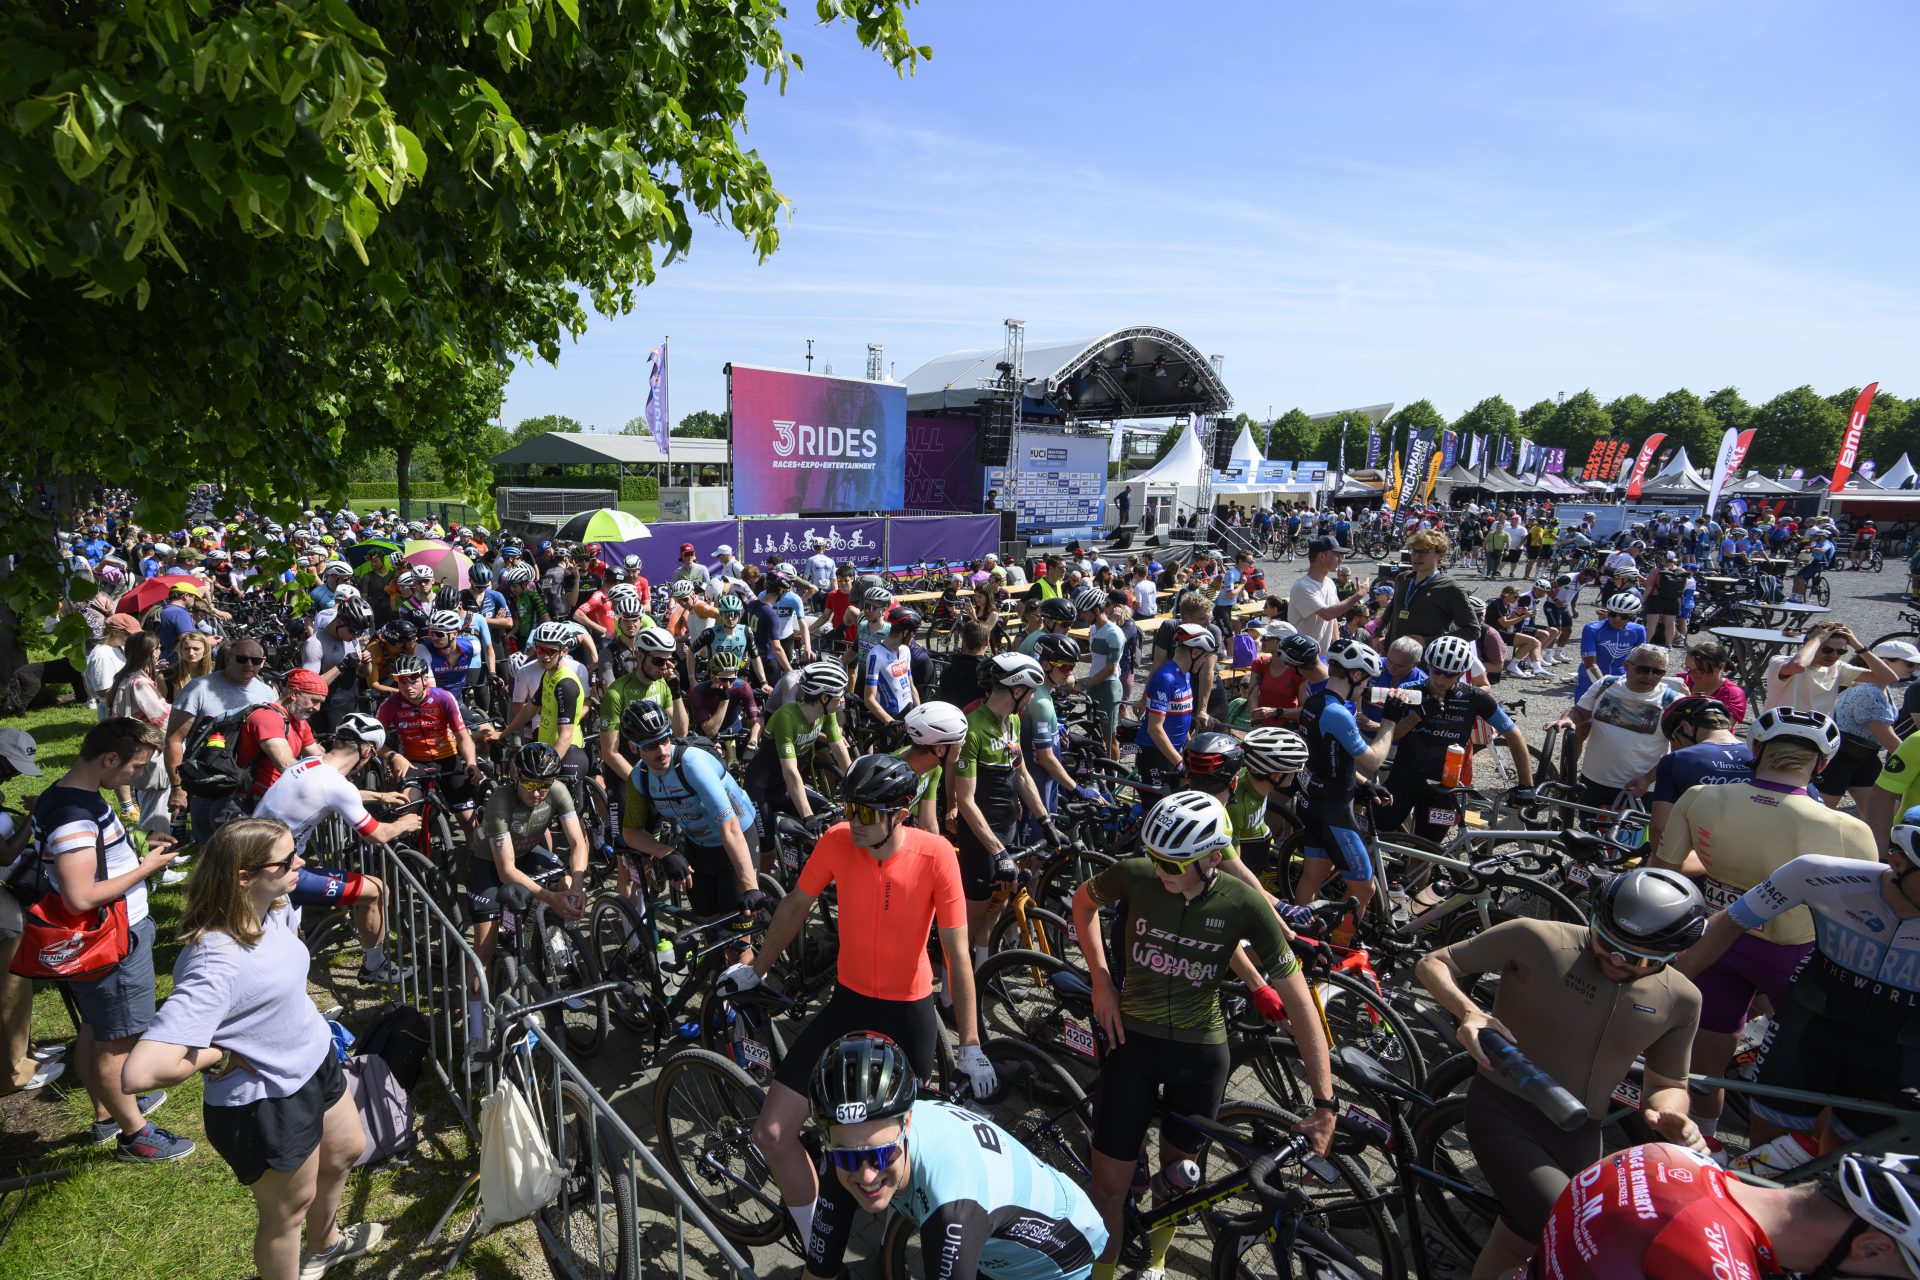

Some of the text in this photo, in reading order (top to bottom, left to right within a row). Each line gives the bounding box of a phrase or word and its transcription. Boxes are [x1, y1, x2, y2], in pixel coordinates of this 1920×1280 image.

[772, 419, 877, 458] 3RIDES
[1840, 411, 1866, 469] BMC
[1033, 449, 1046, 458] UCI
[1583, 439, 1601, 481] MAXXIS
[1599, 440, 1618, 479] MAXXIS
[1636, 445, 1654, 477] LAKE
[772, 460, 876, 470] RACES+EXPO+ENTERTAINMENT
[1400, 439, 1423, 505] KIRCHMAIR
[1431, 811, 1454, 821] 4256
[1805, 875, 1873, 888] CANYON
[1148, 927, 1225, 953] SCOTT
[1822, 959, 1848, 982] THE
[1565, 979, 1595, 1000] STUDIO
[1066, 1028, 1093, 1049] 4202
[744, 1044, 769, 1061] 4299
[837, 1103, 867, 1120] 5172
